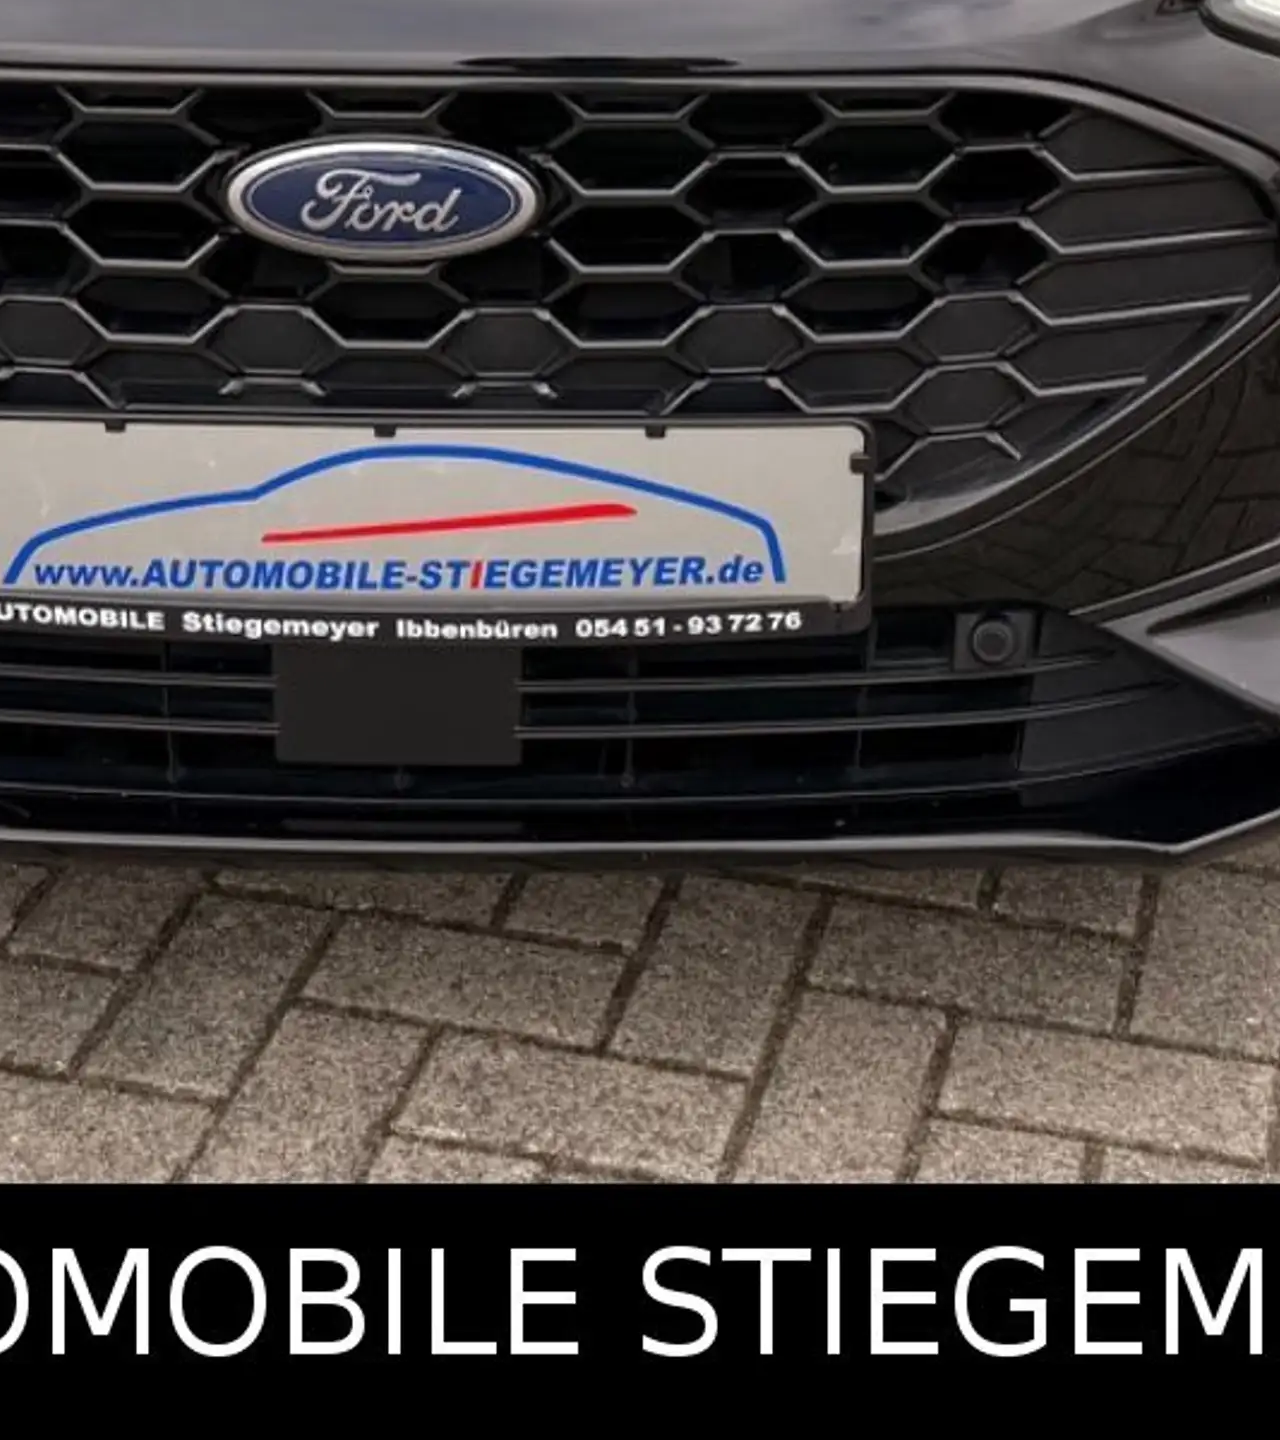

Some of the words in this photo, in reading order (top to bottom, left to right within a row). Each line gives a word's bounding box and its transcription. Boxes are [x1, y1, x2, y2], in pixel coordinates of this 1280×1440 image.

[300, 168, 463, 232] Ford
[34, 555, 765, 592] www.AUTOMOBILE-STIEGEMEYER.de
[182, 611, 381, 641] Stiegemeyer
[395, 617, 558, 639] Ibbenbüren
